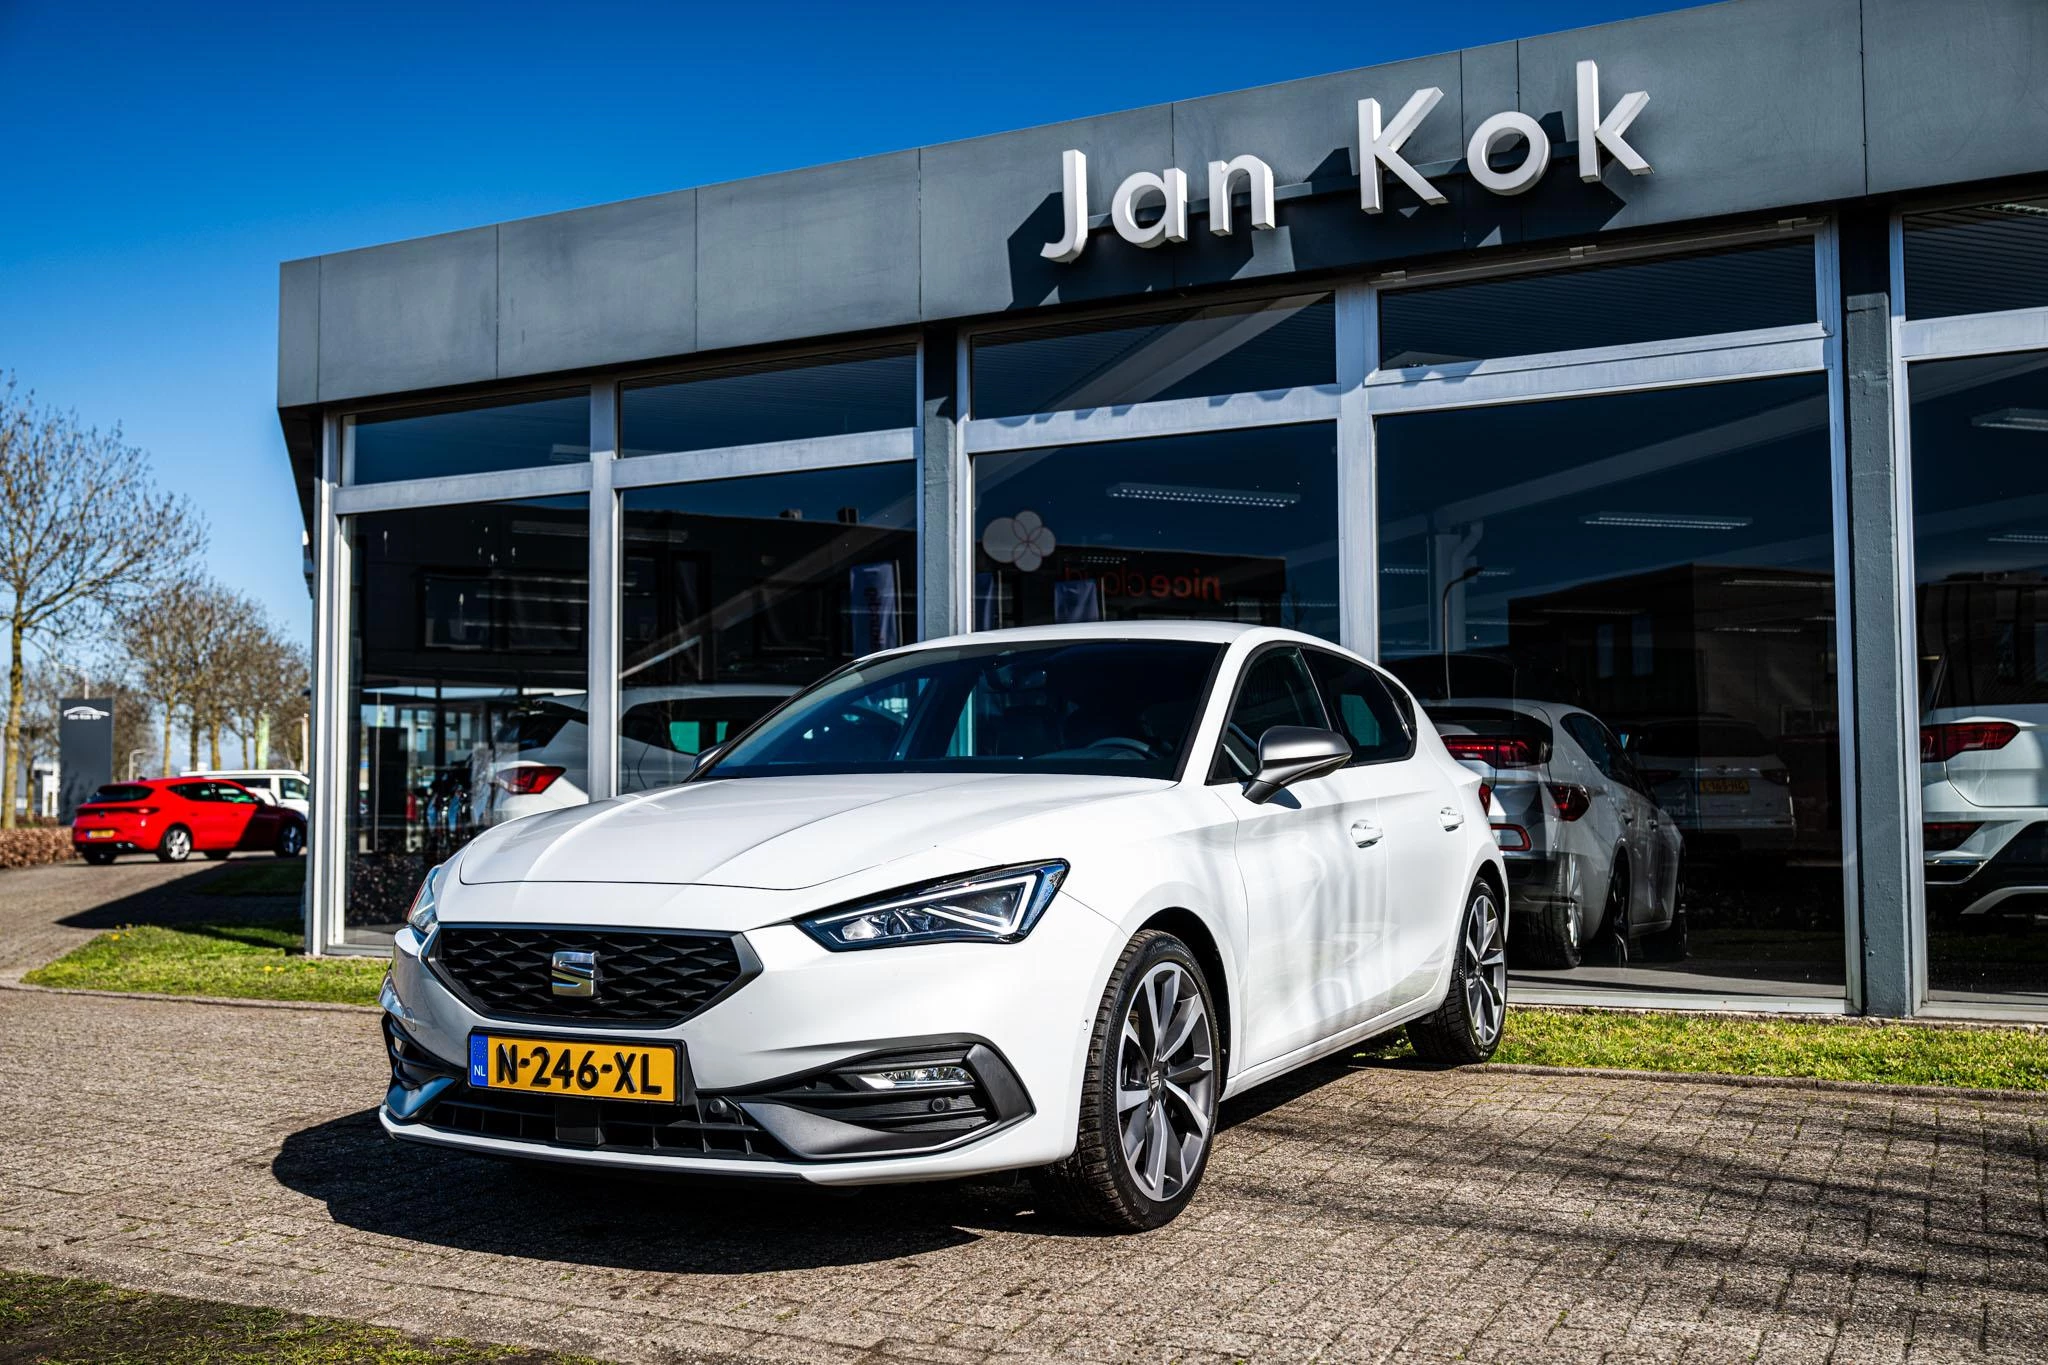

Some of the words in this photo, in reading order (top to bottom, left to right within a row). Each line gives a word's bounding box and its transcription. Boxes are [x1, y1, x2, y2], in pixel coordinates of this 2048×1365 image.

[1041, 149, 1275, 263] Jan
[1357, 59, 1654, 215] Kok
[473, 1064, 487, 1077] NL
[496, 1043, 662, 1095] N-246-XL
